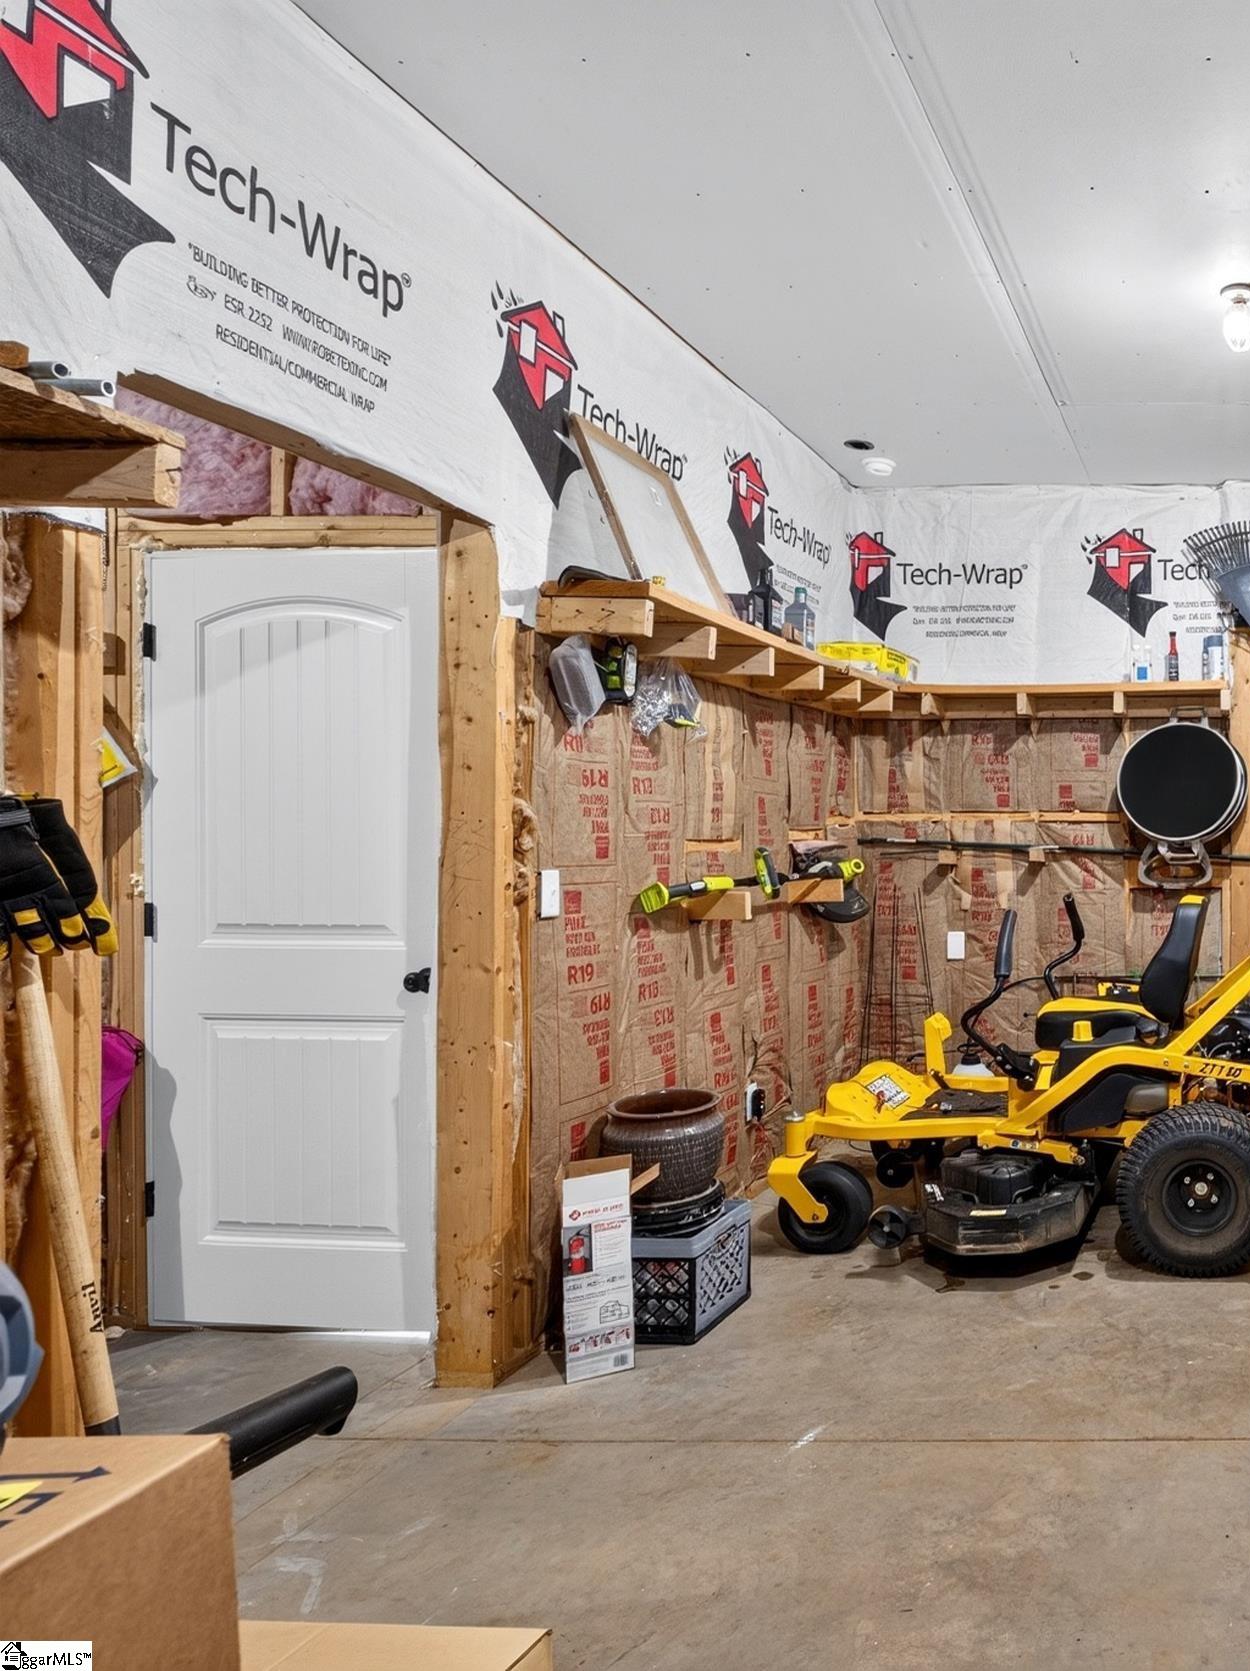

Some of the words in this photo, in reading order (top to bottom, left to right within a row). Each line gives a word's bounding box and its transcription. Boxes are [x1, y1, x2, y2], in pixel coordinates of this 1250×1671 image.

[567, 962, 595, 986] R19
[590, 991, 611, 1015] R19
[81, 1281, 104, 1333] Anvil
